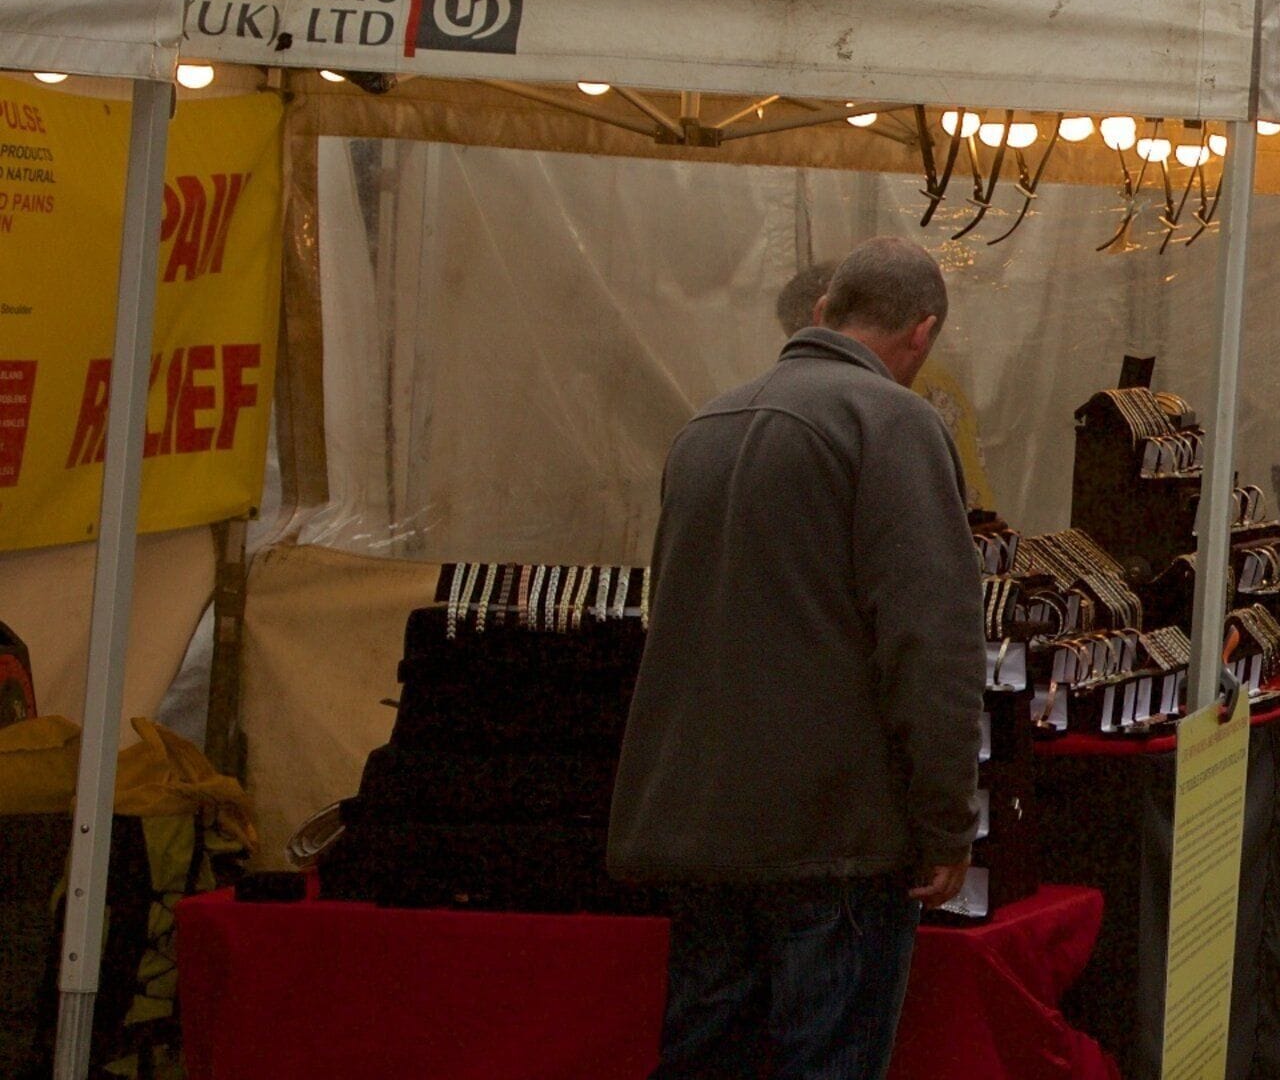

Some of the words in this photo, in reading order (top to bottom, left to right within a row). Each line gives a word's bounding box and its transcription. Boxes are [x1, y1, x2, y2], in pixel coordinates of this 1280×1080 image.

[306, 7, 395, 46] LTD
[0, 100, 46, 133] ULSE
[1, 143, 53, 161] PRODUCTS
[7, 166, 56, 183] NATURAL
[12, 193, 54, 214] PAINS
[65, 343, 261, 470] RLIEF
